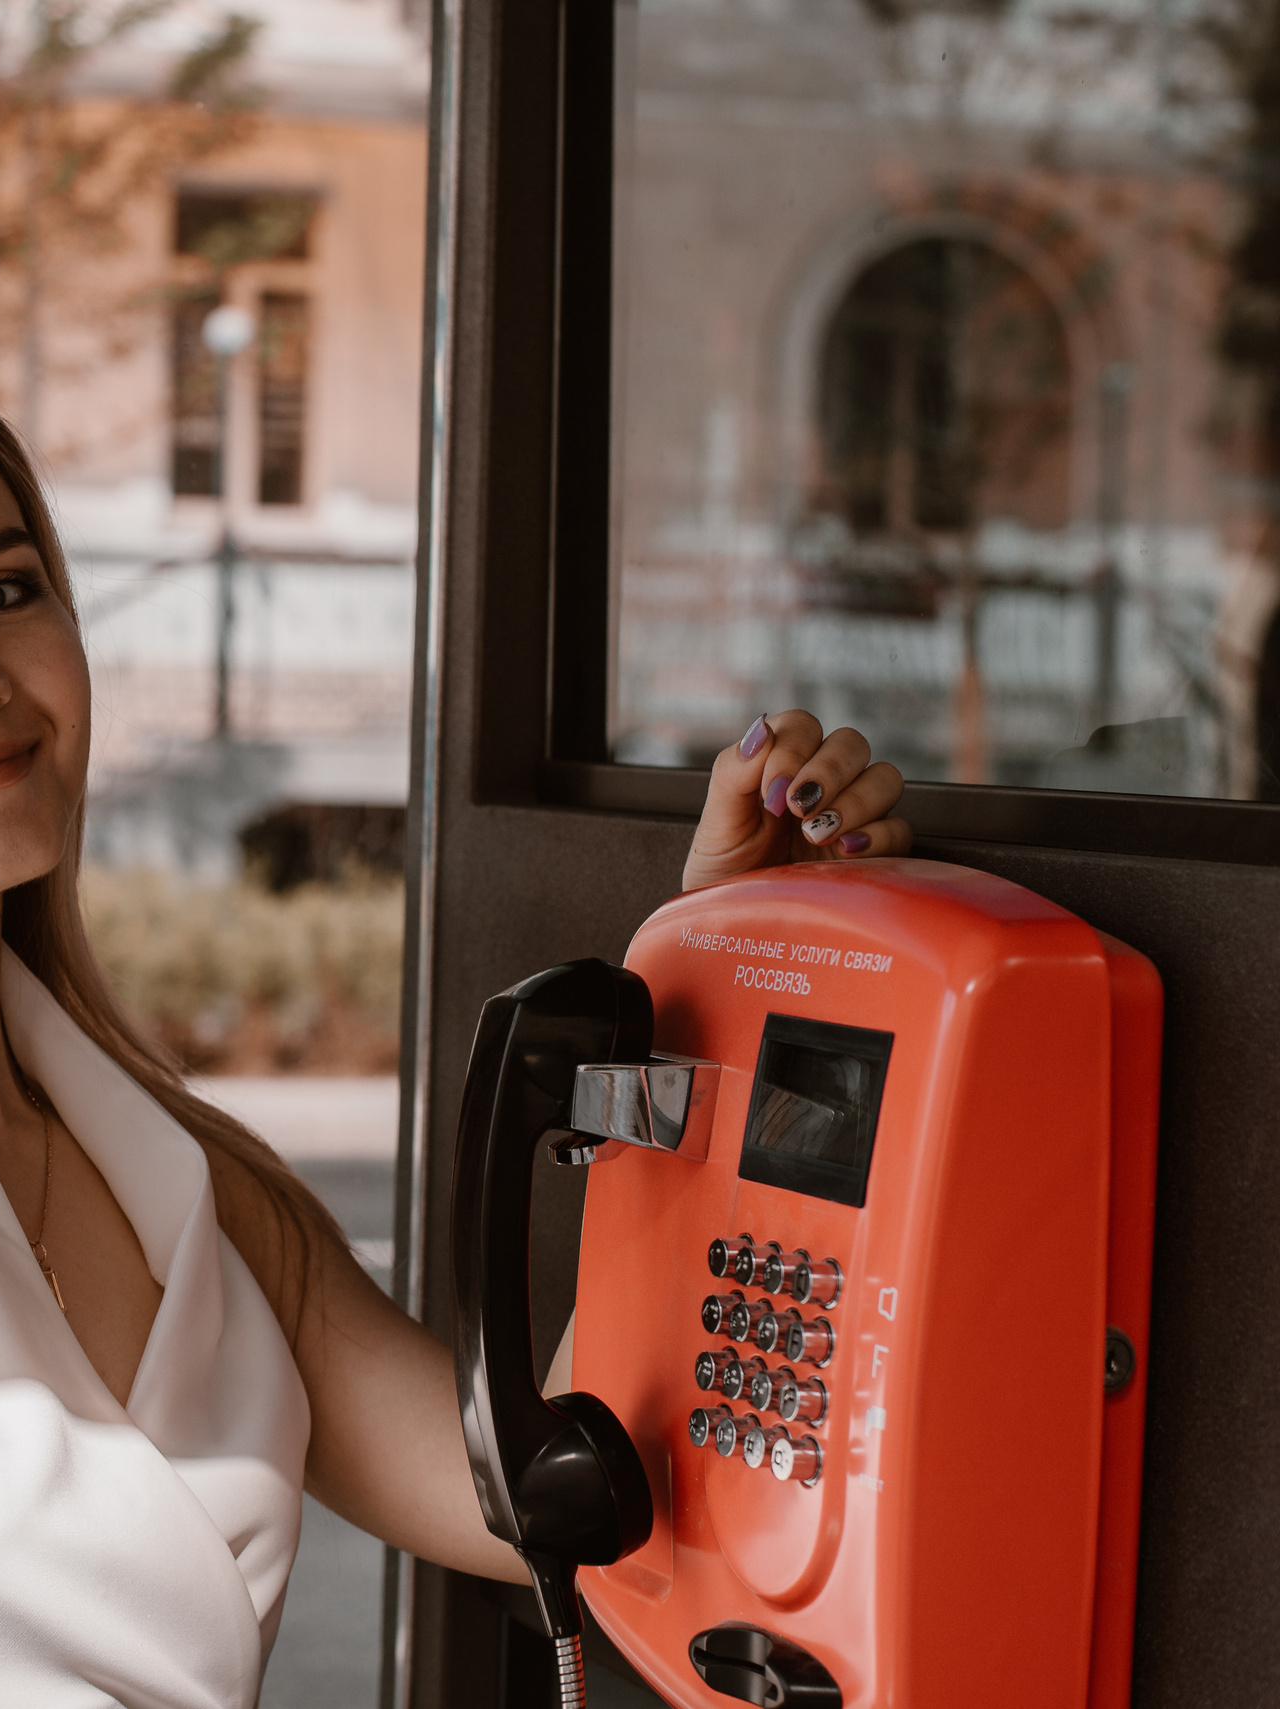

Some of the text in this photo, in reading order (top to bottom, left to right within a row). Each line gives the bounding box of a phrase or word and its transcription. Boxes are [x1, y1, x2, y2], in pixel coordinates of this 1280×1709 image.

[679, 927, 893, 973] УНИВЕРСАЛЬНЫЕ УСЛУГИ СВЯЗИ
[733, 964, 812, 996] РОССВЯЗЬ
[871, 1344, 889, 1379] F
